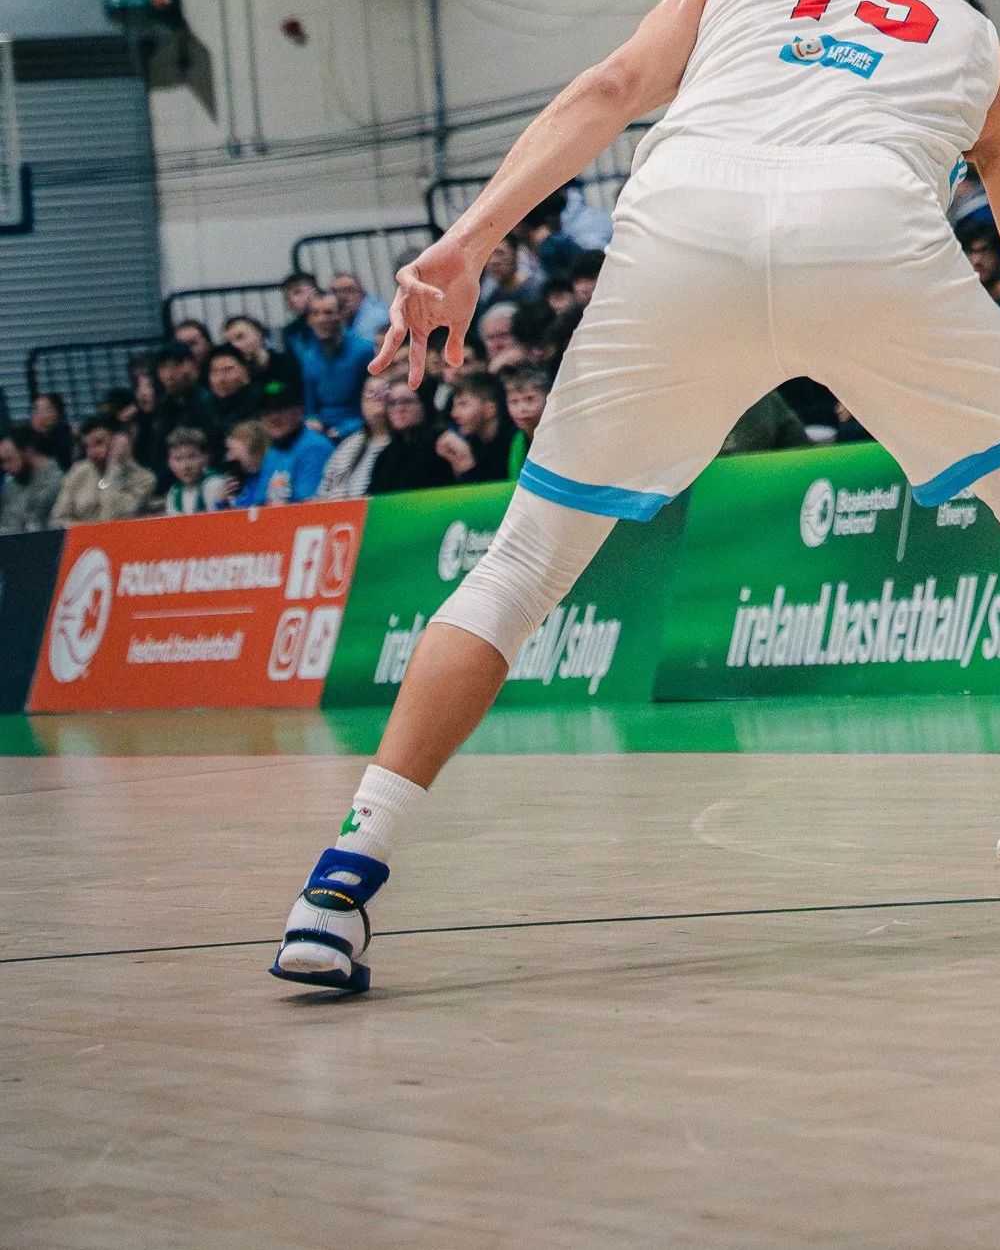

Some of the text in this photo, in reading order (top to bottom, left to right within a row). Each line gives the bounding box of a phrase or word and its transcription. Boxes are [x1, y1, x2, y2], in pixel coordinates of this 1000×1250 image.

[835, 484, 900, 514] Basketball
[117, 551, 284, 598] FOLLOW BASKETBALL
